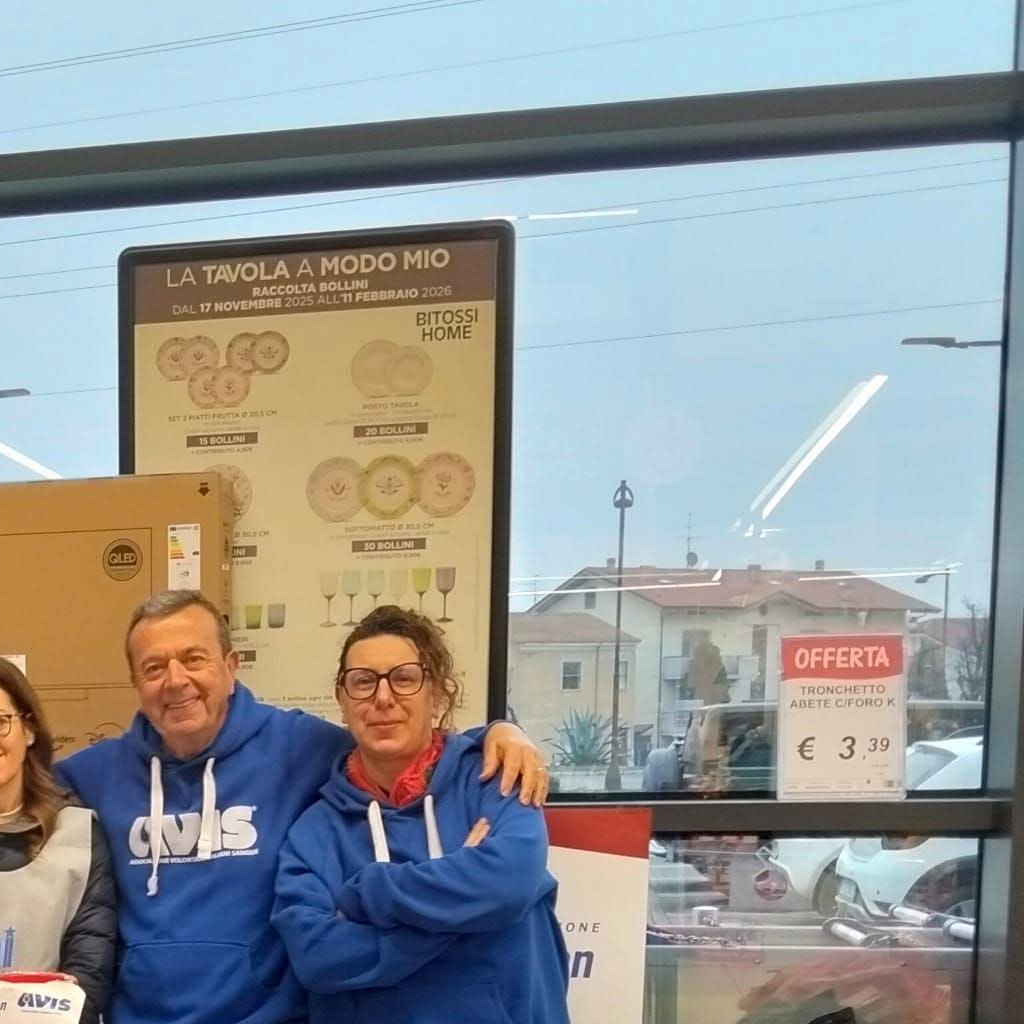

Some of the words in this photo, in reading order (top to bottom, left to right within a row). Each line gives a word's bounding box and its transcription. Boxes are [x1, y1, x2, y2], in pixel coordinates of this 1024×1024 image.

[167, 266, 197, 288] LA
[202, 261, 290, 284] TAVOLA
[296, 260, 315, 279] A
[320, 253, 397, 276] MODO
[403, 248, 451, 271] MIO
[252, 283, 317, 298] RACCOLTA
[319, 279, 369, 293] BOLLINI
[172, 303, 197, 316] DAL
[199, 301, 212, 313] 17
[214, 298, 282, 313] NOVEMBRE
[284, 295, 314, 308] 2025
[355, 288, 419, 302] FEBBRAIO
[421, 285, 453, 299] 2026
[416, 307, 479, 327] BITOSSI
[422, 325, 473, 342] HOME
[379, 424, 417, 435] BOLLINI
[199, 437, 208, 446] 15
[209, 435, 246, 445] BOLLINI
[378, 540, 415, 551] BOLLINI
[108, 551, 137, 565] QLED
[793, 646, 890, 669] OFFERTA
[800, 684, 886, 696] TRONCHETTO
[790, 699, 833, 710] ABETE
[834, 698, 883, 709] C/FORO
[887, 697, 896, 708] K
[796, 736, 817, 761] €
[560, 922, 601, 934] ONE
[16, 991, 72, 1012] AVIS
